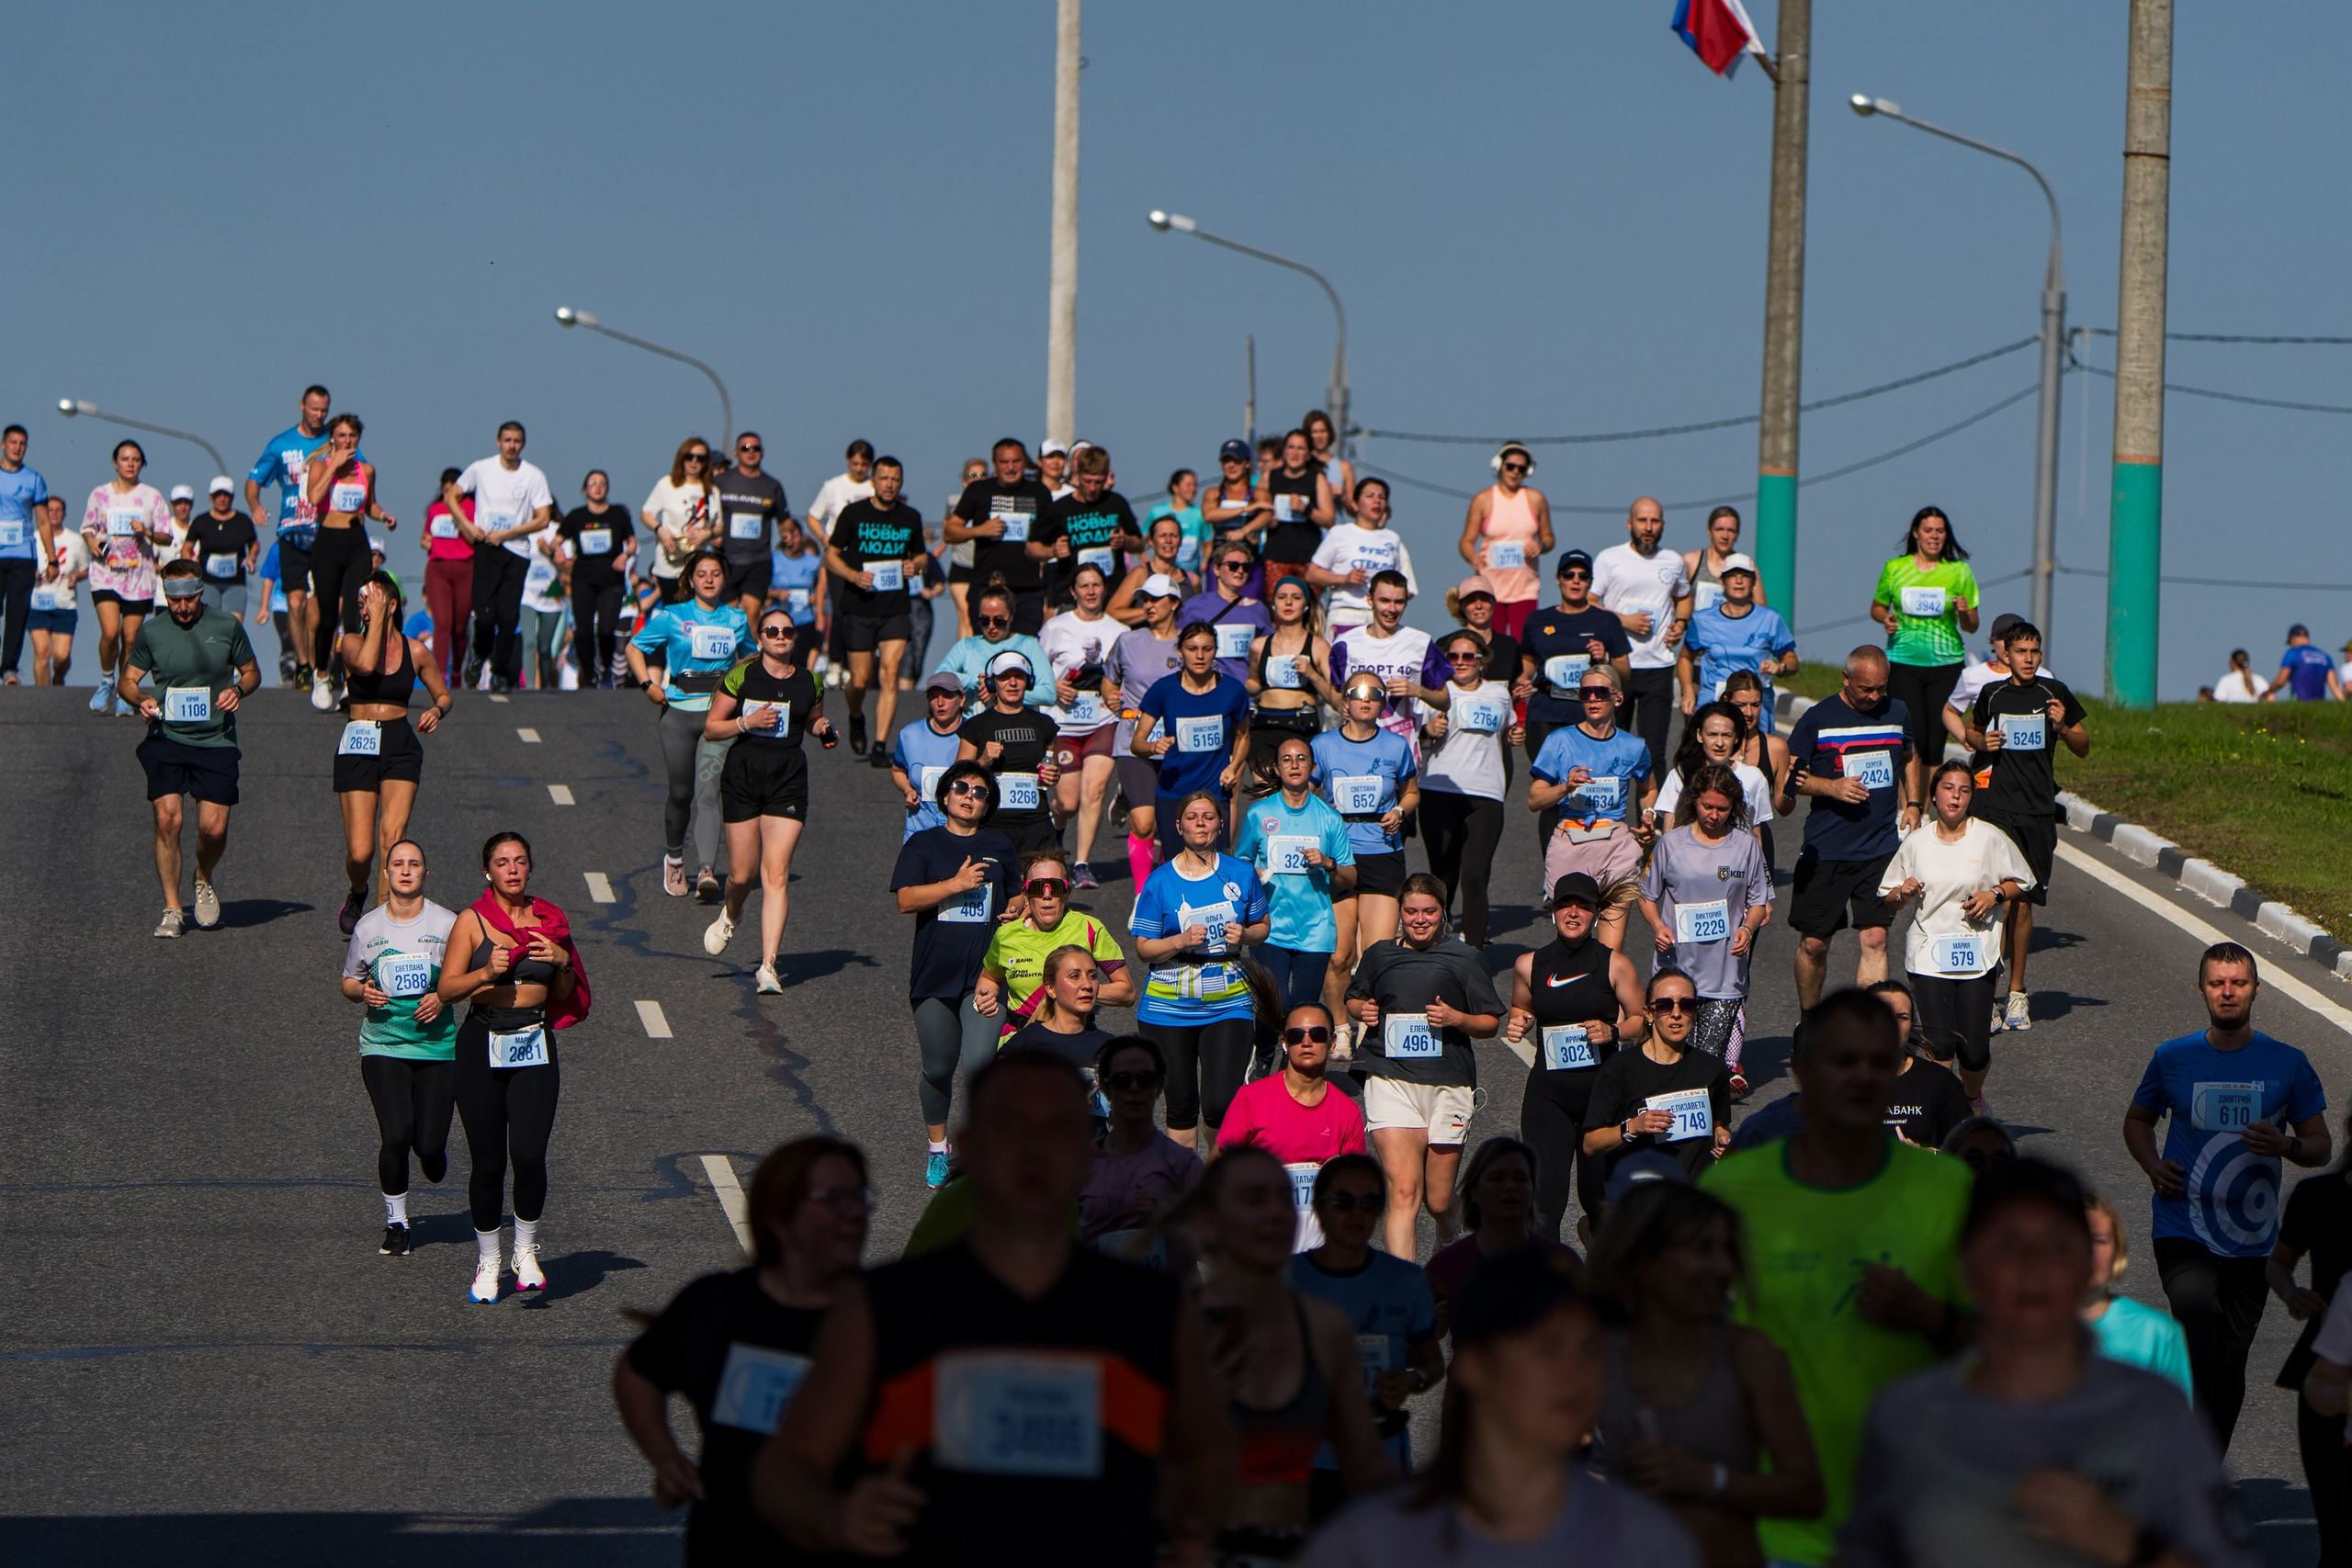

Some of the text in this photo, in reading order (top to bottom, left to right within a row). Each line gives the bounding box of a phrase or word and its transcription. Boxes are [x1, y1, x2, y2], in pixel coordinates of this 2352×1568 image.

[1067, 513, 1119, 533] НОВЫЕ
[858, 526, 912, 541] НОВЫЕ
[1070, 527, 1113, 547] ЛЮДИ
[858, 541, 906, 555] ЛЮДИ
[1917, 600, 1941, 613] 3942
[710, 642, 729, 655] 476
[1350, 664, 1413, 675] СПОРТ 40
[1283, 671, 1297, 683] 38
[1563, 671, 1583, 684] 148
[181, 704, 207, 717] 1108
[1070, 706, 1092, 719] 532
[1473, 711, 1498, 728] 2764
[995, 728, 1036, 743] PUMA
[1193, 724, 1219, 733] АНАСТАСИЯ
[350, 736, 376, 750] 2625
[1193, 732, 1220, 748] 5156
[2014, 731, 2041, 746] 5245
[1865, 761, 1883, 769] СЕРГЕЙ
[1861, 769, 1890, 785] 2424
[1010, 790, 1037, 804] 3268
[1353, 794, 1375, 808] 652
[1585, 795, 1614, 808] 4634
[1284, 854, 1307, 869] 324
[963, 892, 981, 900] ОЛЬГА
[961, 901, 984, 917] 409
[1695, 910, 1723, 920] ВИКТОРИЯ
[1205, 913, 1224, 924] ОЛЬГА
[1694, 919, 1725, 937] 2229
[367, 939, 390, 949] ELIKOR
[1952, 942, 1971, 950] МАРИЯ
[1951, 950, 1974, 966] 579
[395, 964, 424, 973] СВЕТЛАНА
[395, 973, 427, 991] 2588
[1402, 1034, 1436, 1052] 4961
[1565, 1034, 1585, 1044] ИРИНА
[509, 1043, 542, 1063] 2881
[1560, 1043, 1596, 1064] 3023
[2218, 1094, 2251, 1105] ДМИТРИЙ
[1671, 1101, 1706, 1113] ЕЛИЗАВЕТА
[1678, 1111, 1706, 1133] 748
[2220, 1106, 2250, 1125] 610
[1295, 1175, 1317, 1184] ТАТЬЯ
[1294, 1186, 1313, 1206] 17
